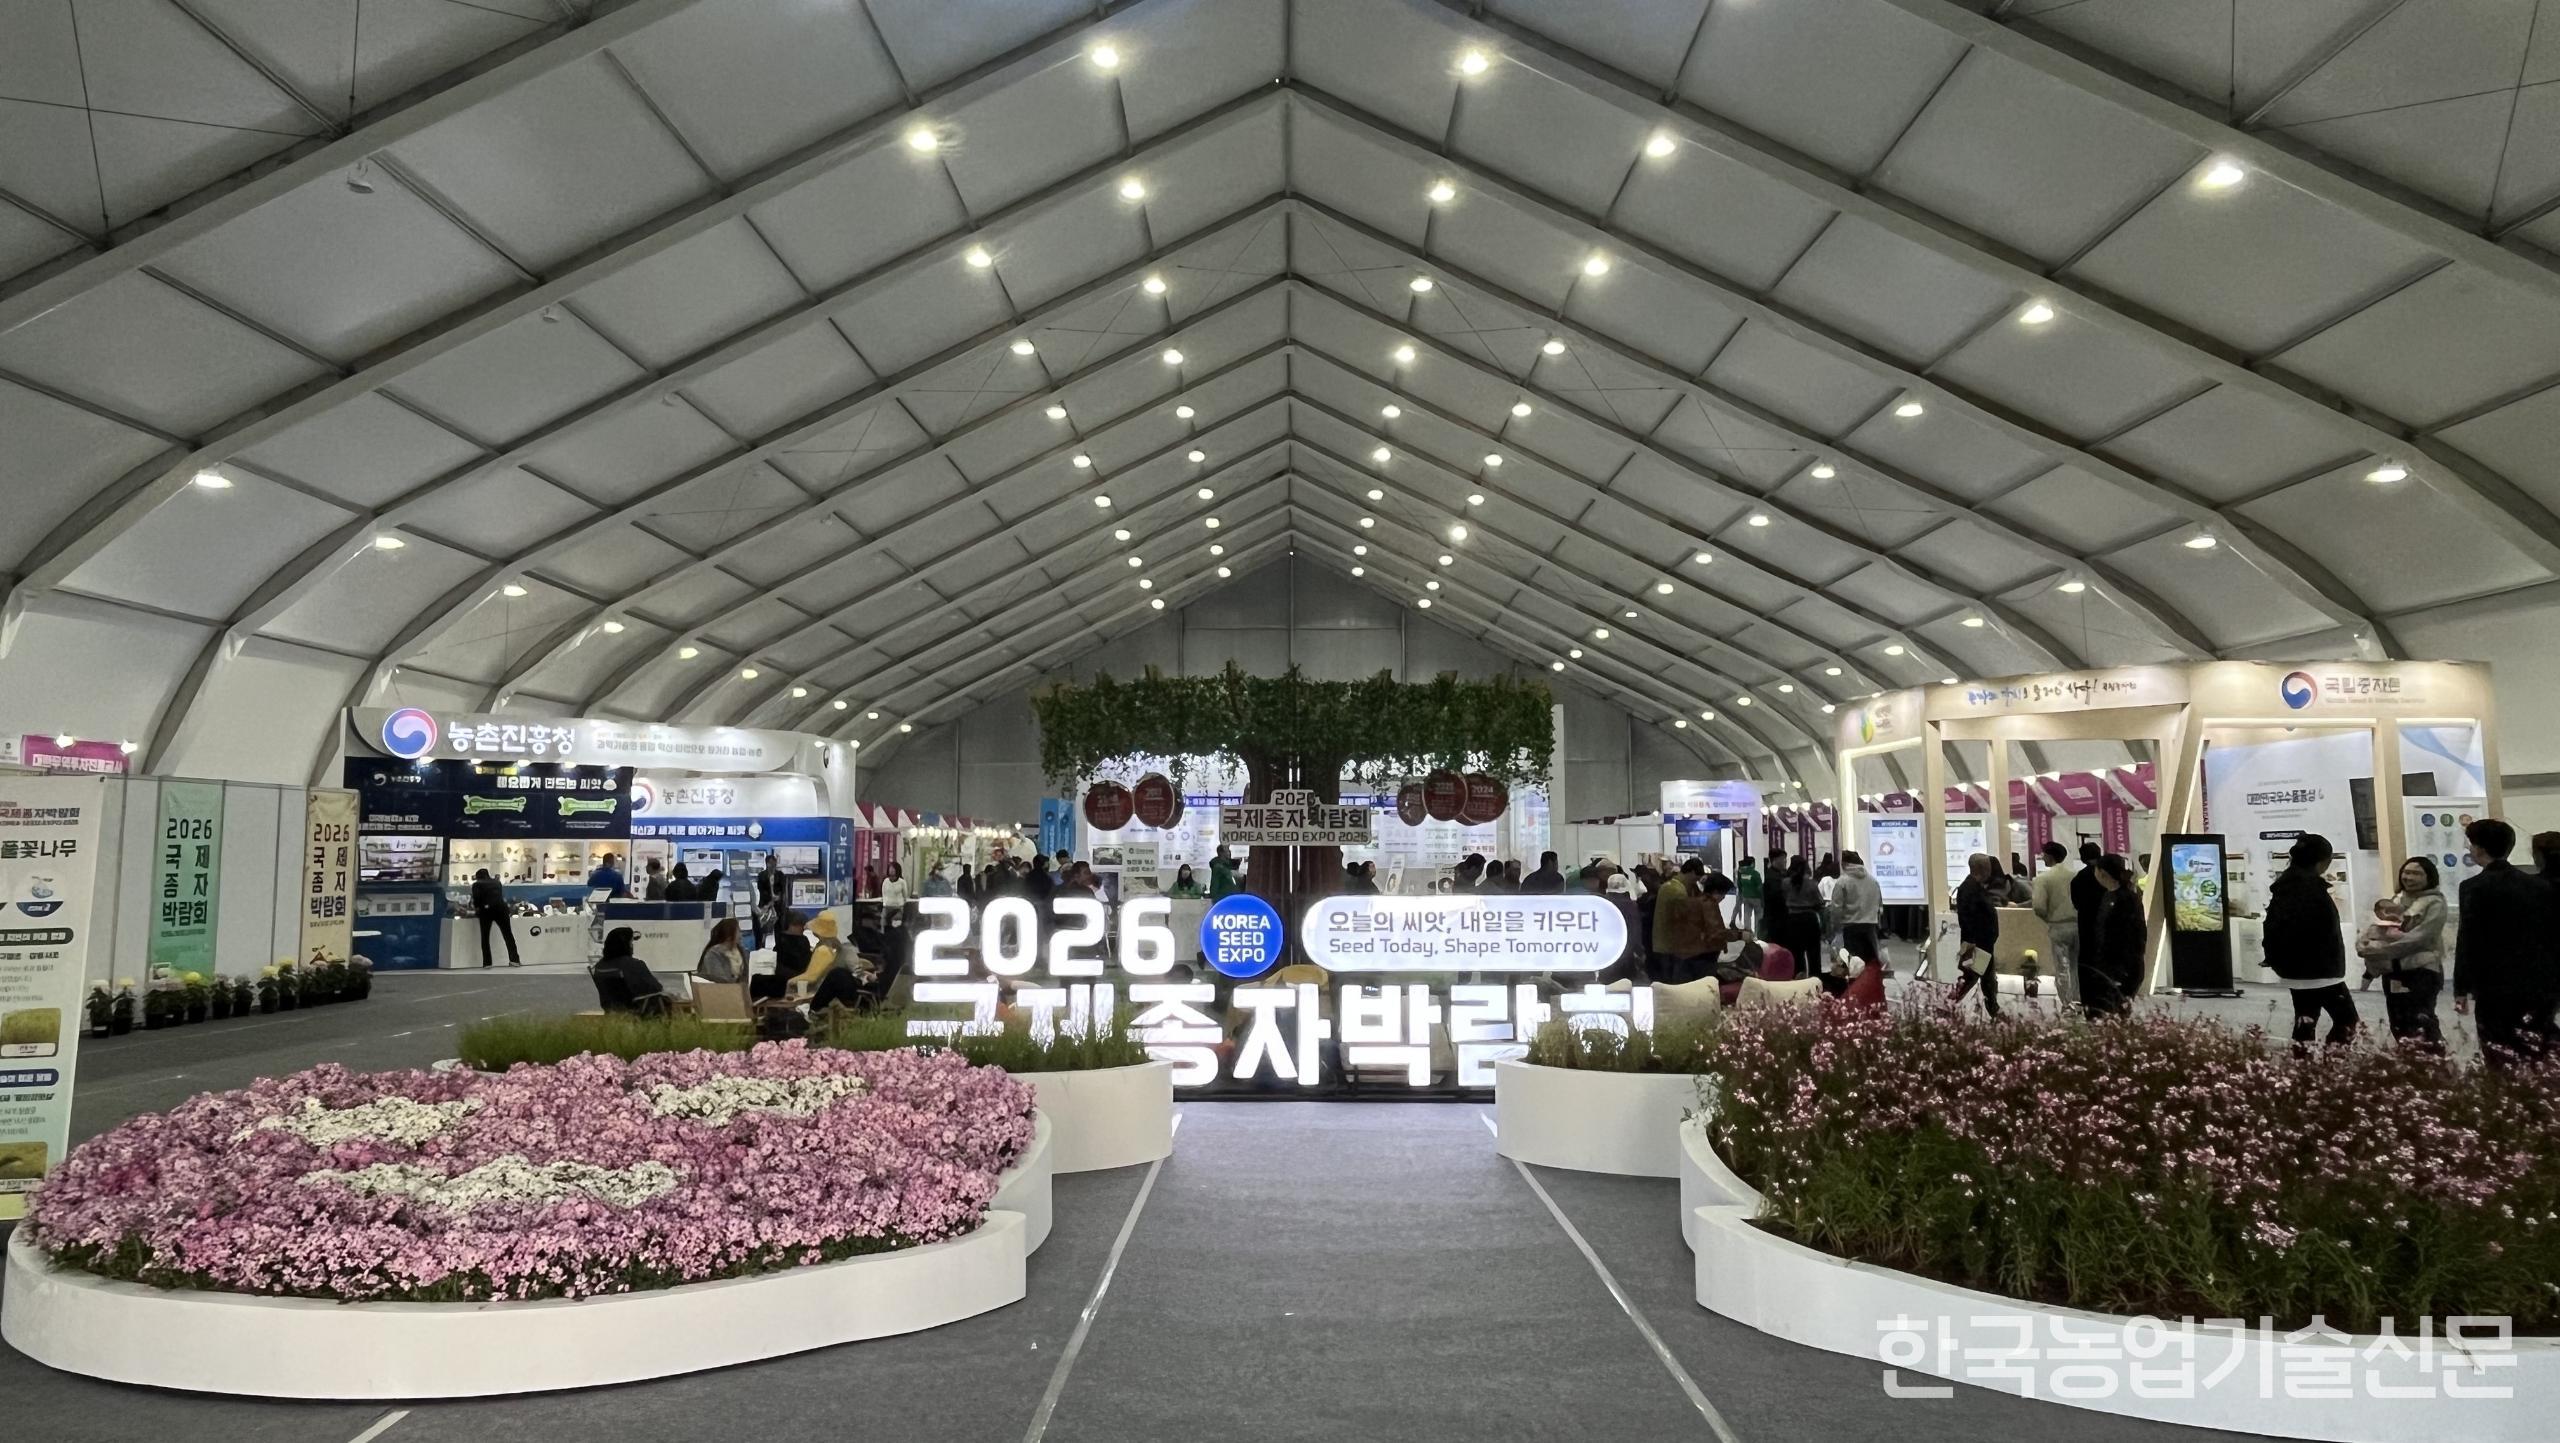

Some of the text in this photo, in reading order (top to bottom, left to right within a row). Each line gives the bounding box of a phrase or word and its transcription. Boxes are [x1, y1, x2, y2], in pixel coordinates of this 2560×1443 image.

[447, 721, 576, 755] 농촌진흥청
[662, 788, 735, 805] 농촌진흥청
[166, 818, 212, 839] 2026
[1223, 808, 1368, 829] 국제종자박람회
[313, 823, 350, 842] 2026
[1222, 831, 1369, 842] KOREA SEED EXPO 2026
[162, 900, 208, 927] 박람회
[310, 895, 346, 919] 박람회
[1212, 914, 1271, 930] KOREA
[1328, 910, 1600, 934] 오늘의 씨앗, 내일을 키우다
[914, 896, 1176, 976] 2026
[1219, 931, 1265, 946] SEED
[1218, 947, 1265, 963] EXPO
[1329, 938, 1600, 958] Seed Today, Shape Tomorrow
